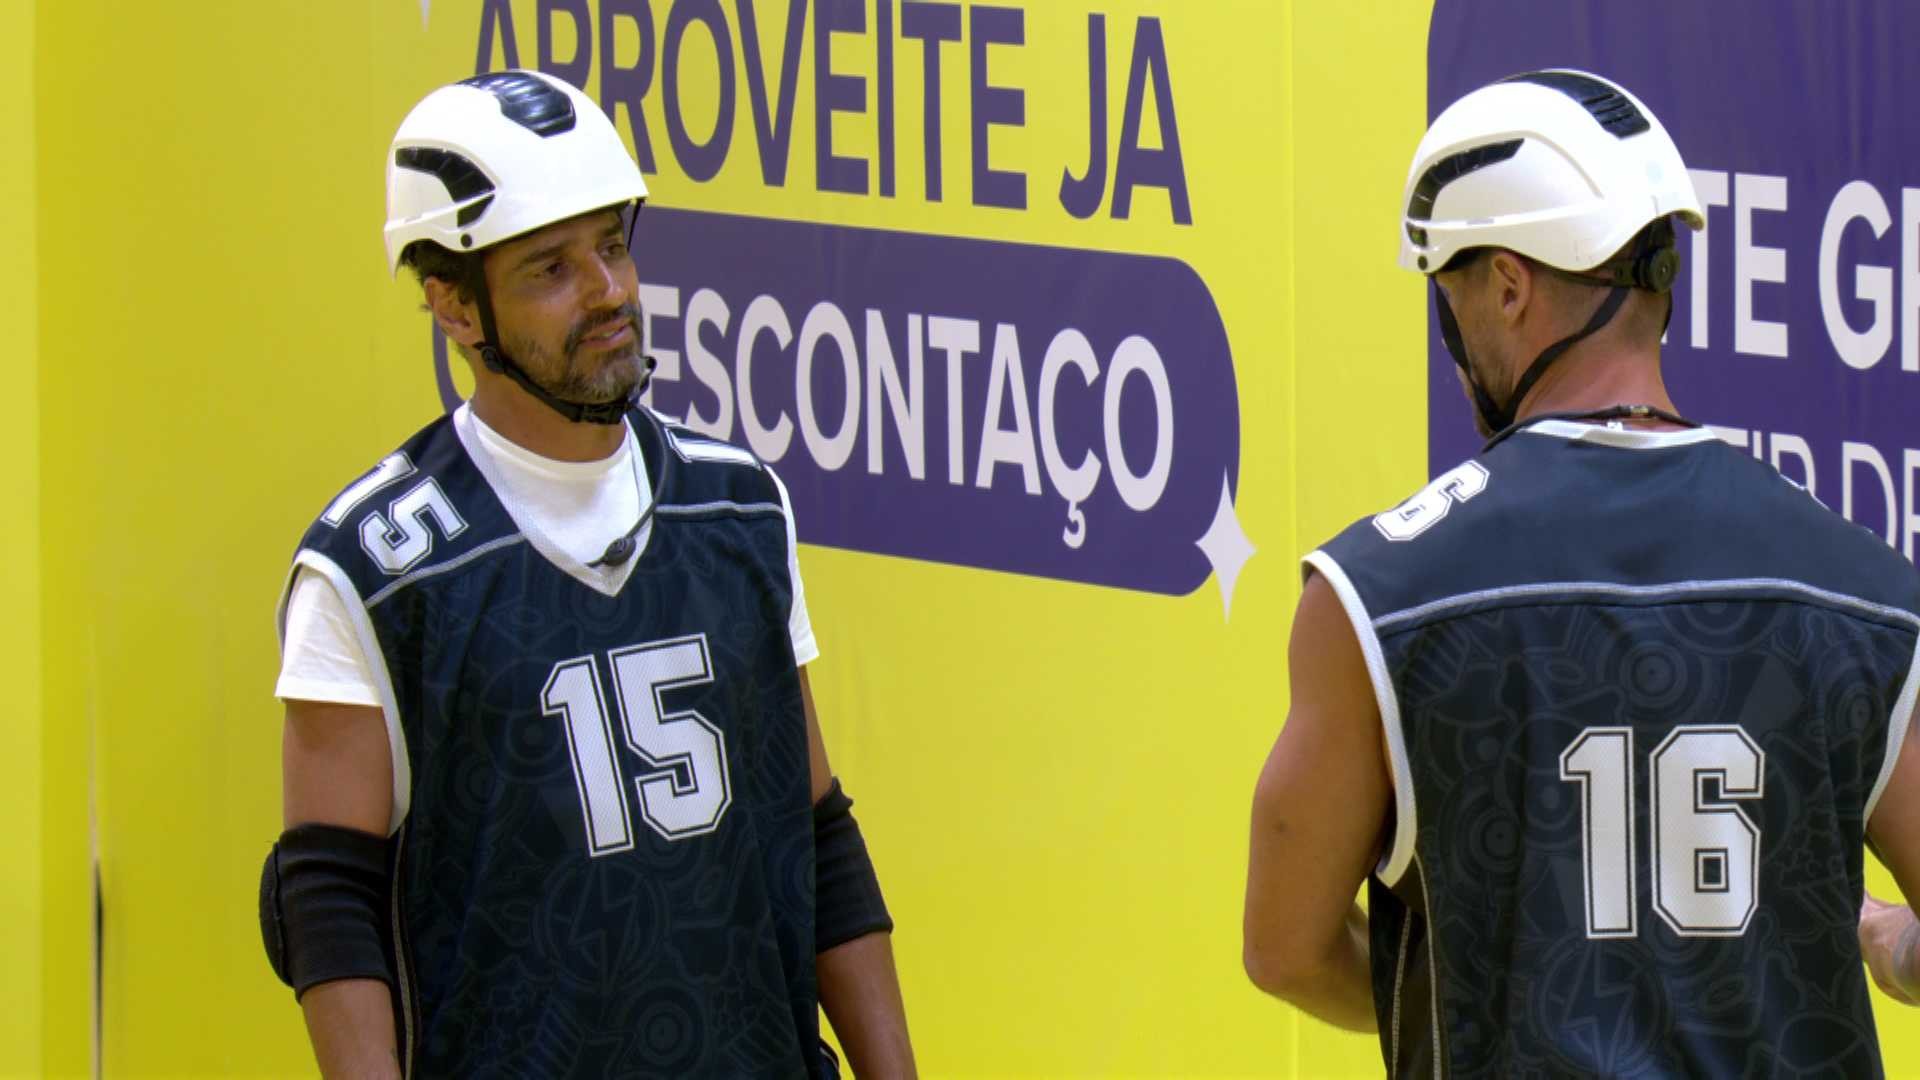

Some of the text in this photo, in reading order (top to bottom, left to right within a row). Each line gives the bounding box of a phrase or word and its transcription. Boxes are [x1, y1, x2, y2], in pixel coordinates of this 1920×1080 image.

[1661, 168, 1788, 358] TE
[320, 450, 469, 575] 15
[638, 283, 1174, 548] ESCONTAÇO
[540, 633, 732, 856] 15
[1559, 724, 1765, 939] 16
